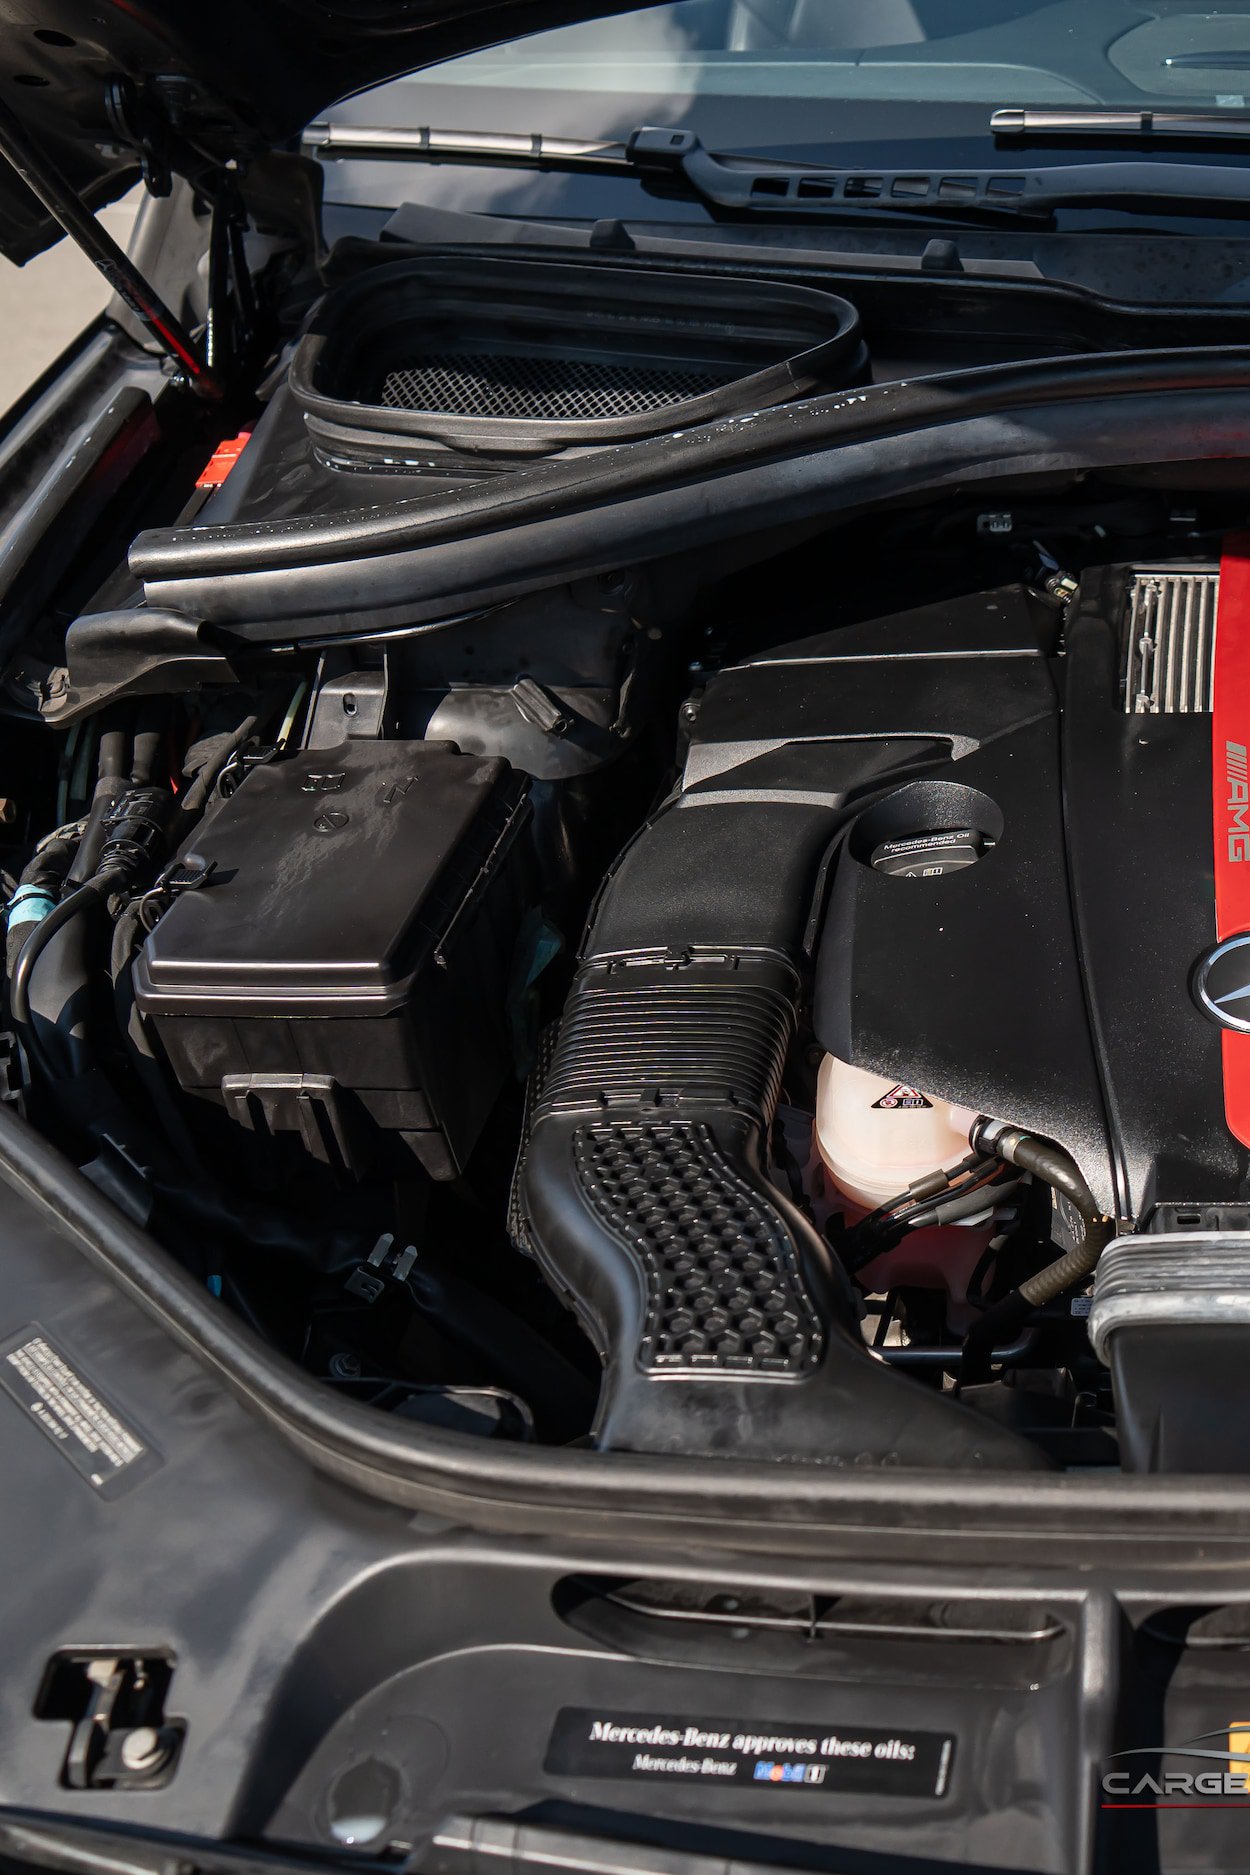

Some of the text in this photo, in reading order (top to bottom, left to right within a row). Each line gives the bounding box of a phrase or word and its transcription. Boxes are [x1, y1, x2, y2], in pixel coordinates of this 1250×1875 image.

[1227, 777, 1250, 862] AMG
[883, 834, 954, 850] Mercedes-Benz
[891, 838, 957, 853] recommended
[589, 1720, 916, 1761] Mercedes-Benz approves these oils:
[632, 1753, 738, 1776] Mercedes-Benz
